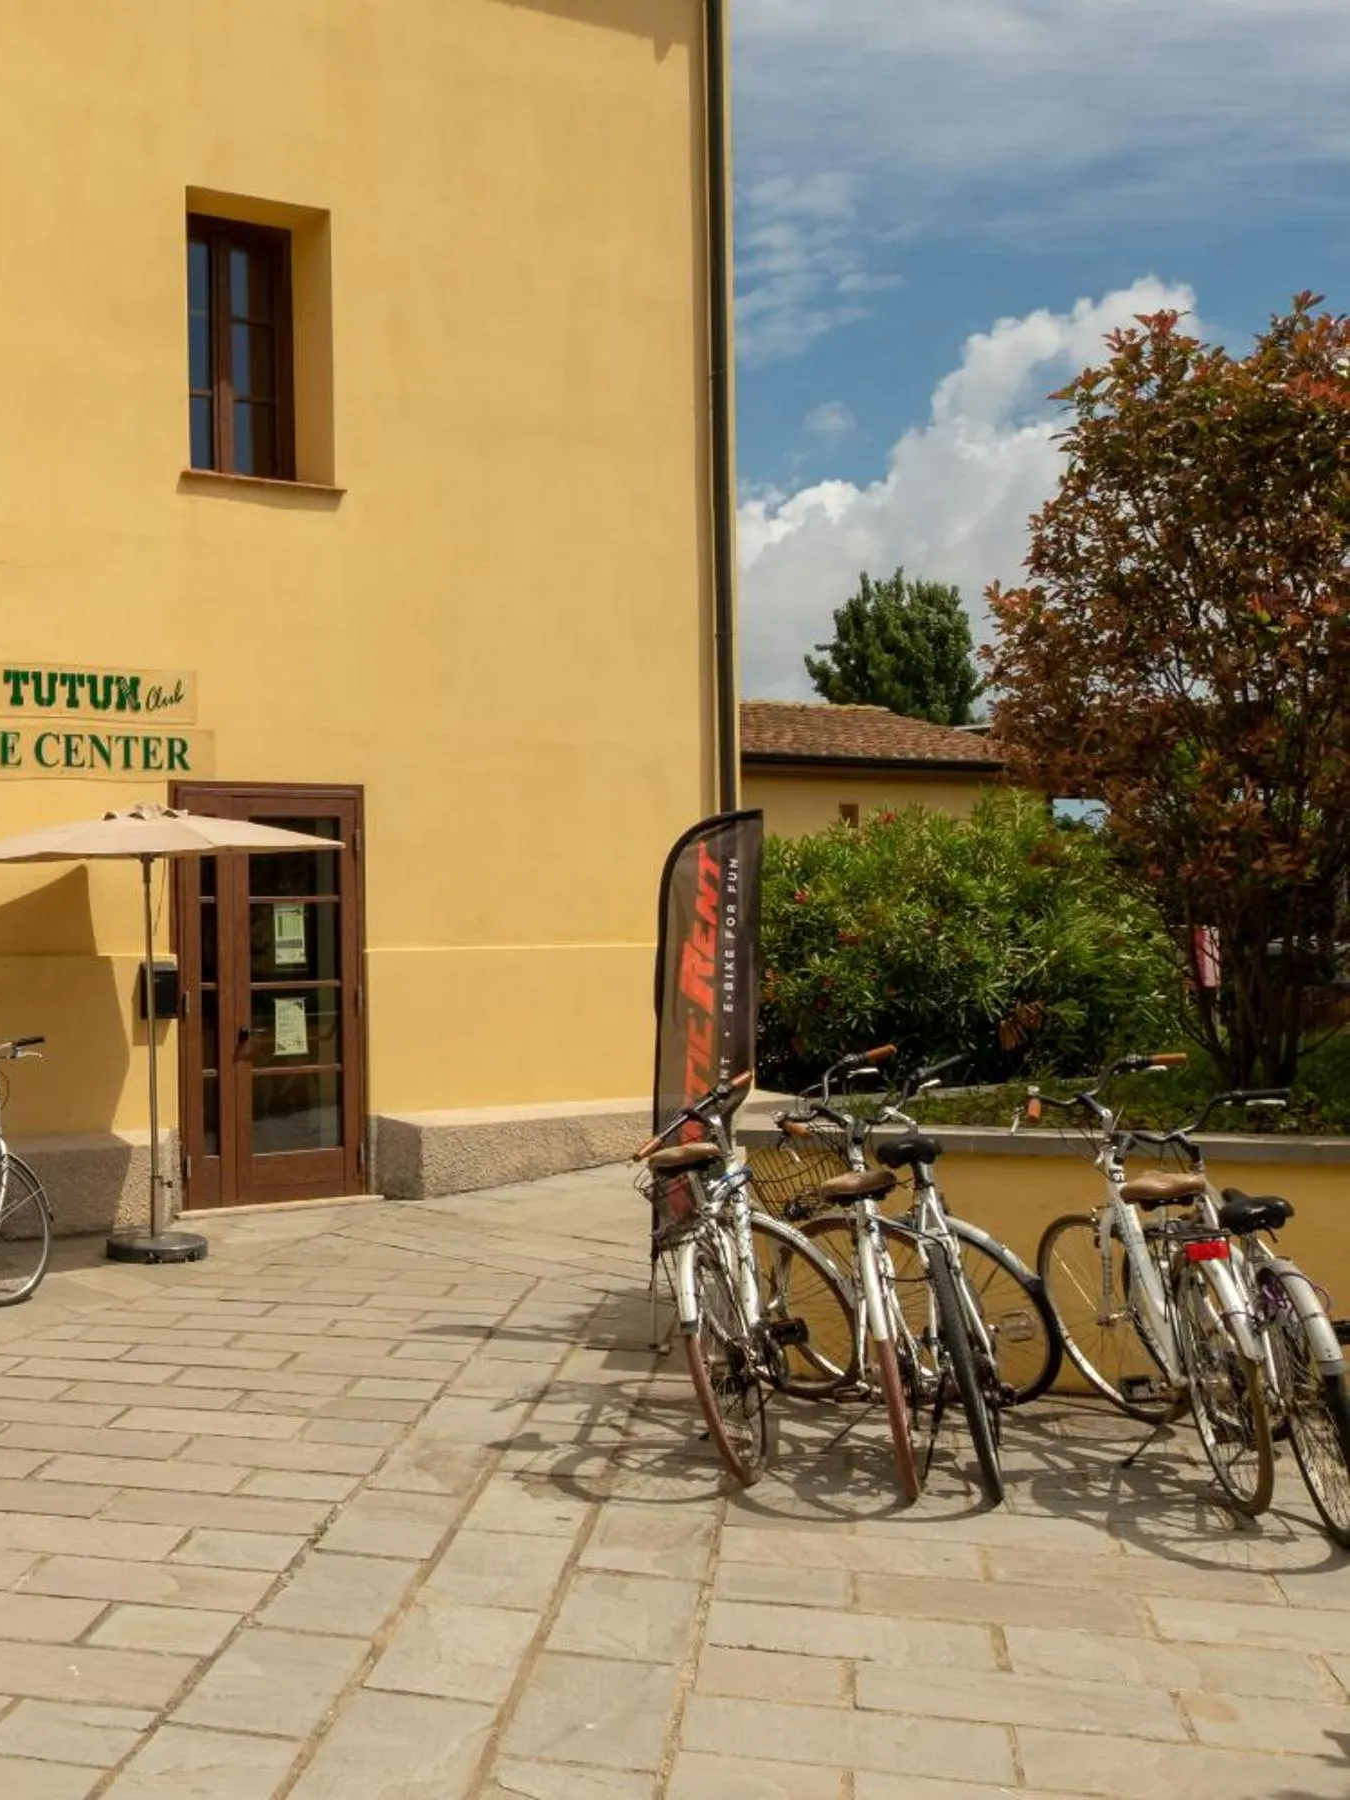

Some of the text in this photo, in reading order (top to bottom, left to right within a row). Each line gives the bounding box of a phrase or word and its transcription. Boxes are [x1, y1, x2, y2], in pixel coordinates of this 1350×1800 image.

[146, 679, 185, 712] Club
[34, 731, 191, 771] CENTER
[727, 858, 740, 894] FUN
[724, 904, 738, 940] FOR
